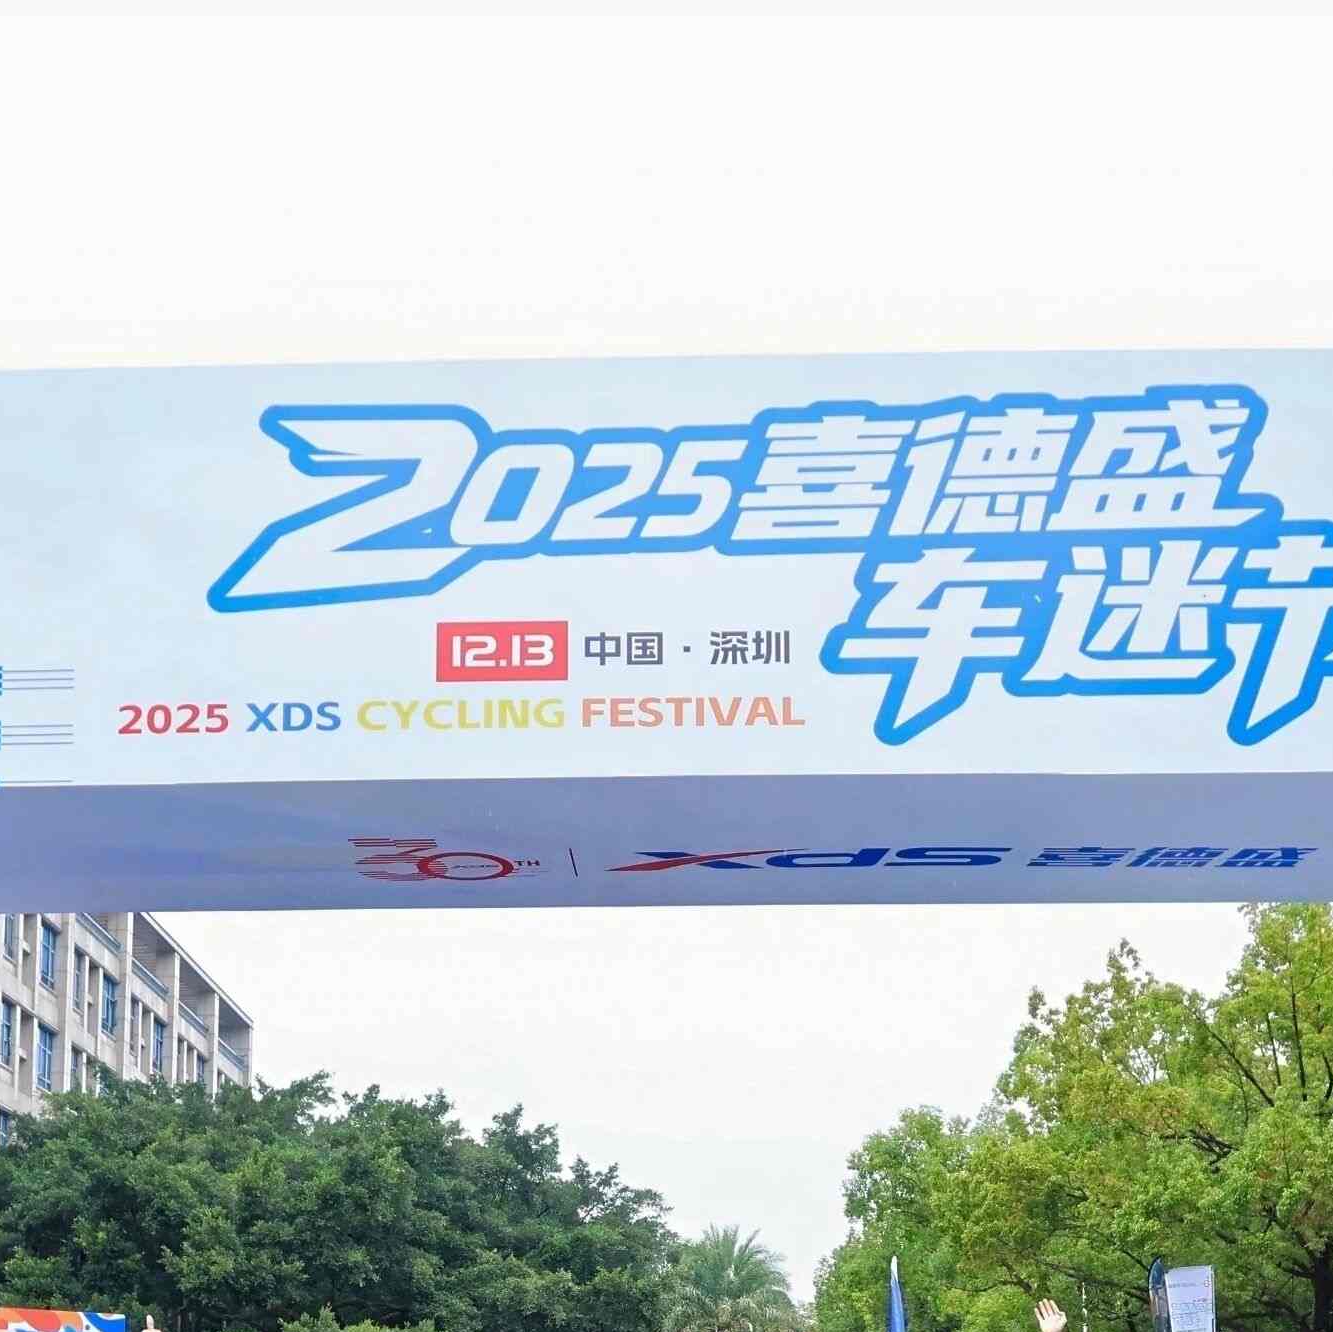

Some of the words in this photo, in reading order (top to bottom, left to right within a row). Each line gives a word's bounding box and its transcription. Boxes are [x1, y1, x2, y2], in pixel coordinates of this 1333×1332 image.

[451, 635, 554, 667] 12.13
[117, 704, 229, 735] 2025
[245, 702, 341, 732] XDS
[357, 699, 565, 731] CYCLING
[581, 696, 806, 727] FESTIVAL
